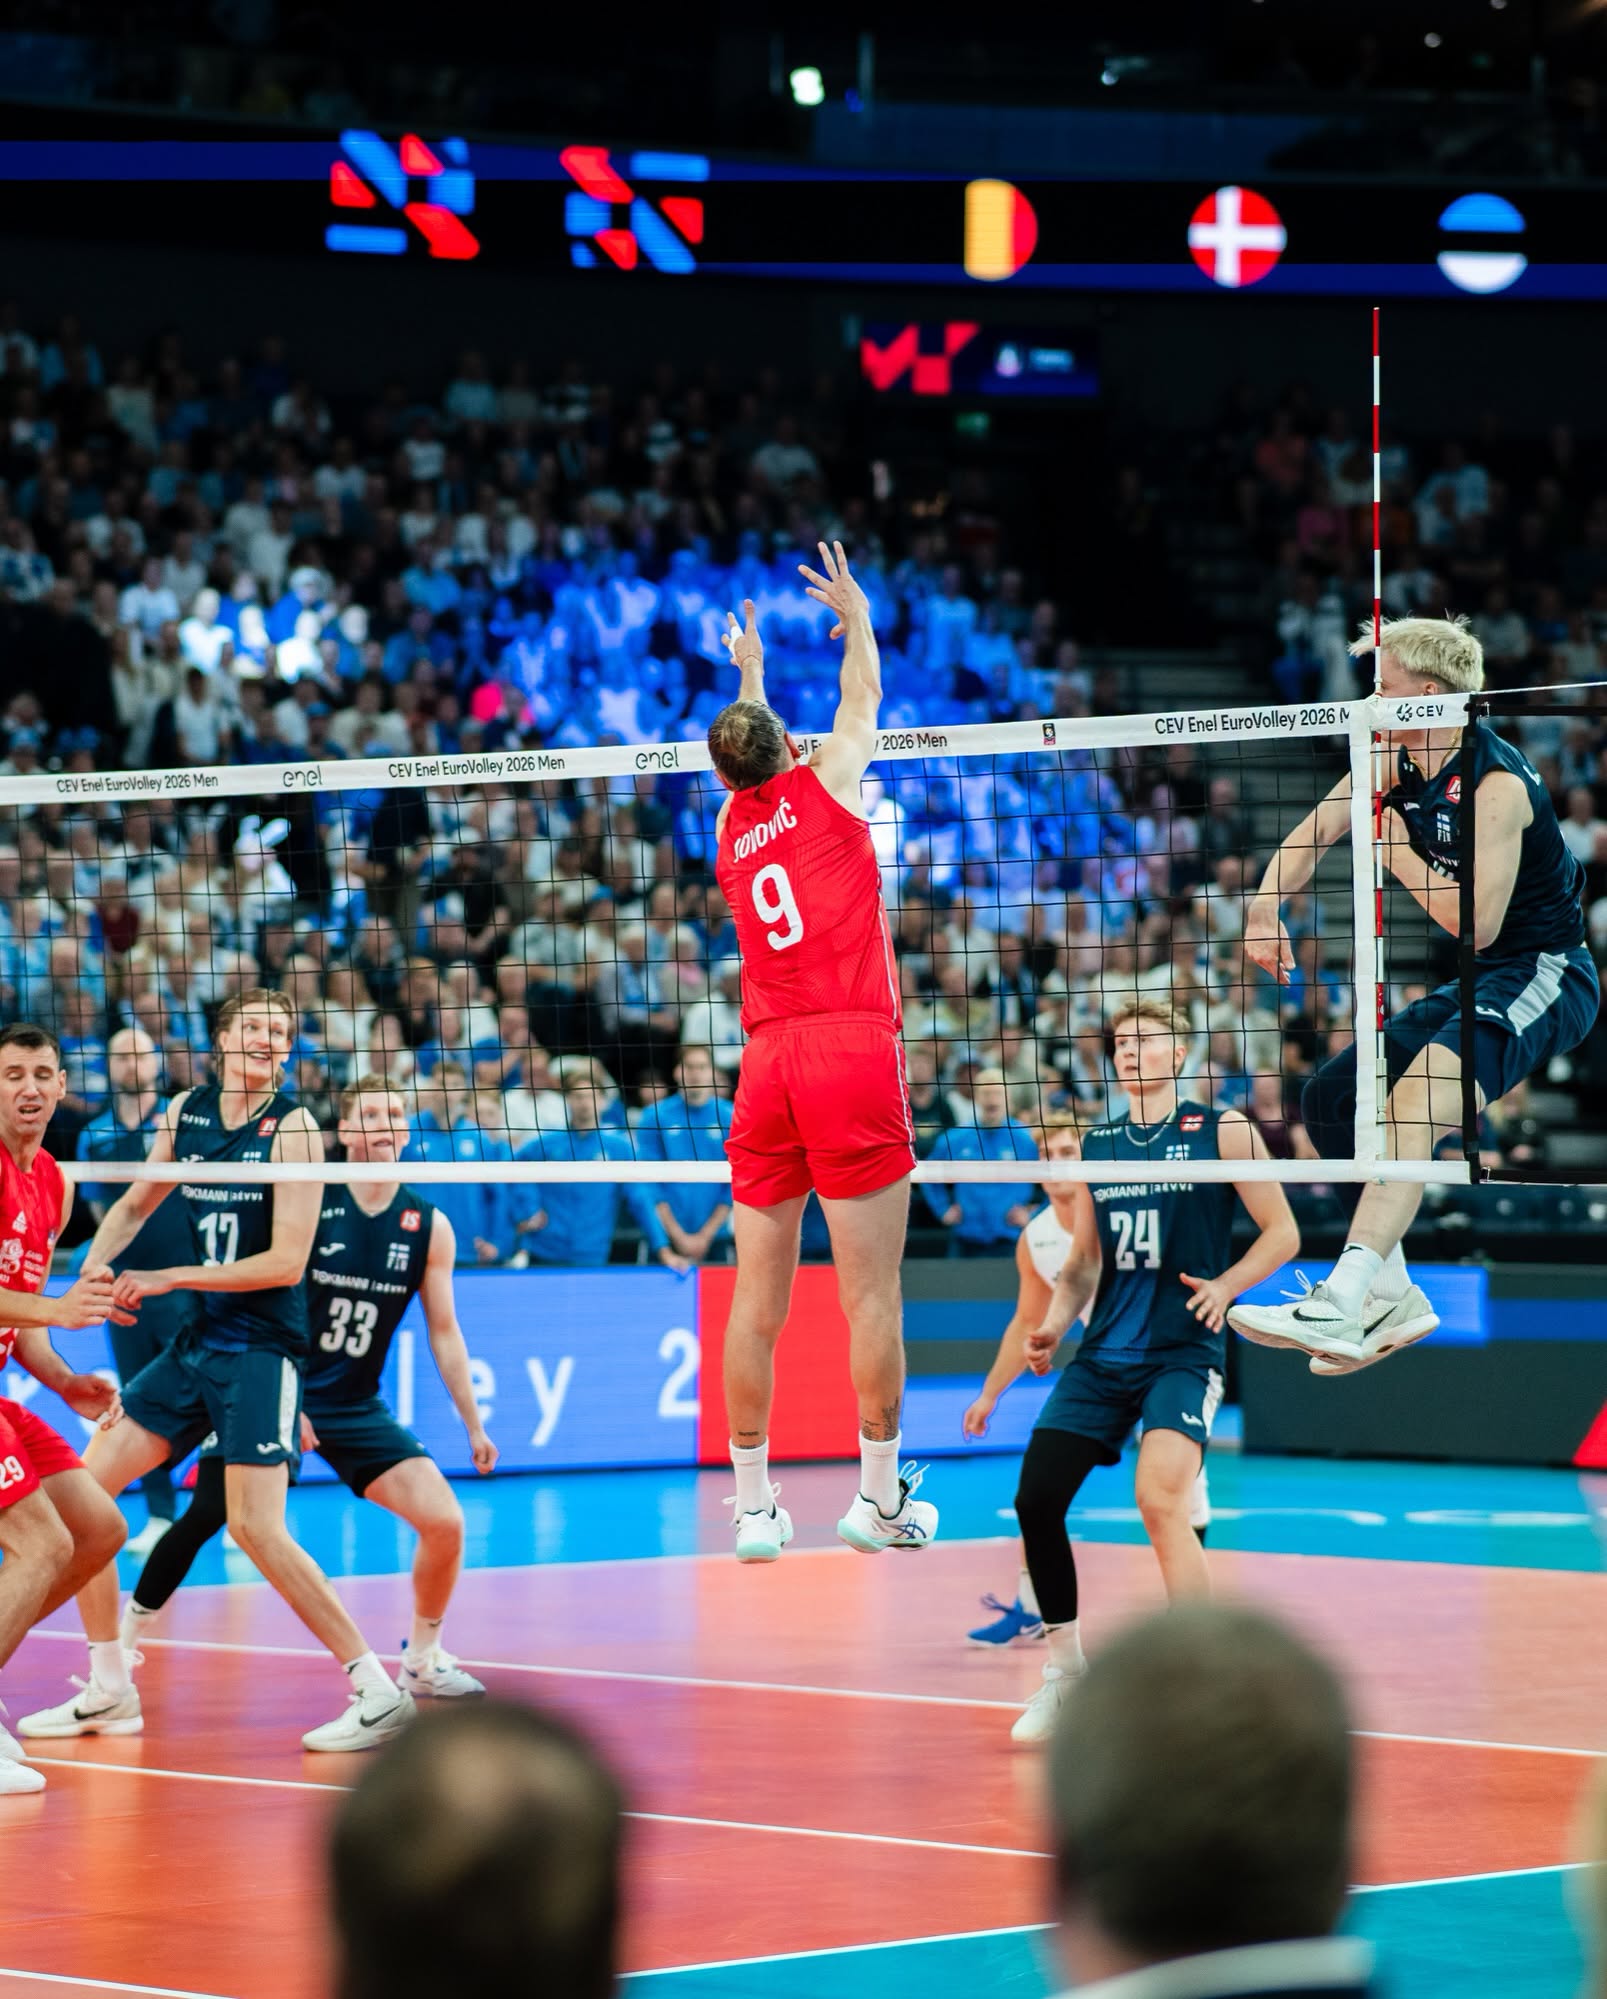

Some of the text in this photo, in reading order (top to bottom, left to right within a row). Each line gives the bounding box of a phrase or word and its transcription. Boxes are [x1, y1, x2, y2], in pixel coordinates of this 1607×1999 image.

[1154, 717, 1185, 734] CEV
[1188, 714, 1218, 733] Enel
[1221, 710, 1297, 731] EuroVolley
[1300, 708, 1336, 726] 2026
[1415, 704, 1445, 718] CEV
[882, 734, 914, 751] 2026
[917, 732, 948, 749] Men
[388, 755, 566, 778] CEV Enel EuroVolley 2026 Men
[635, 746, 680, 770] enel
[56, 773, 219, 793] CEV Enel EuroVolley 2026 Men
[282, 765, 323, 787] enel
[752, 863, 804, 951] 9
[198, 1212, 240, 1268] 17
[1109, 1208, 1162, 1271] 24
[319, 1296, 379, 1359] 33
